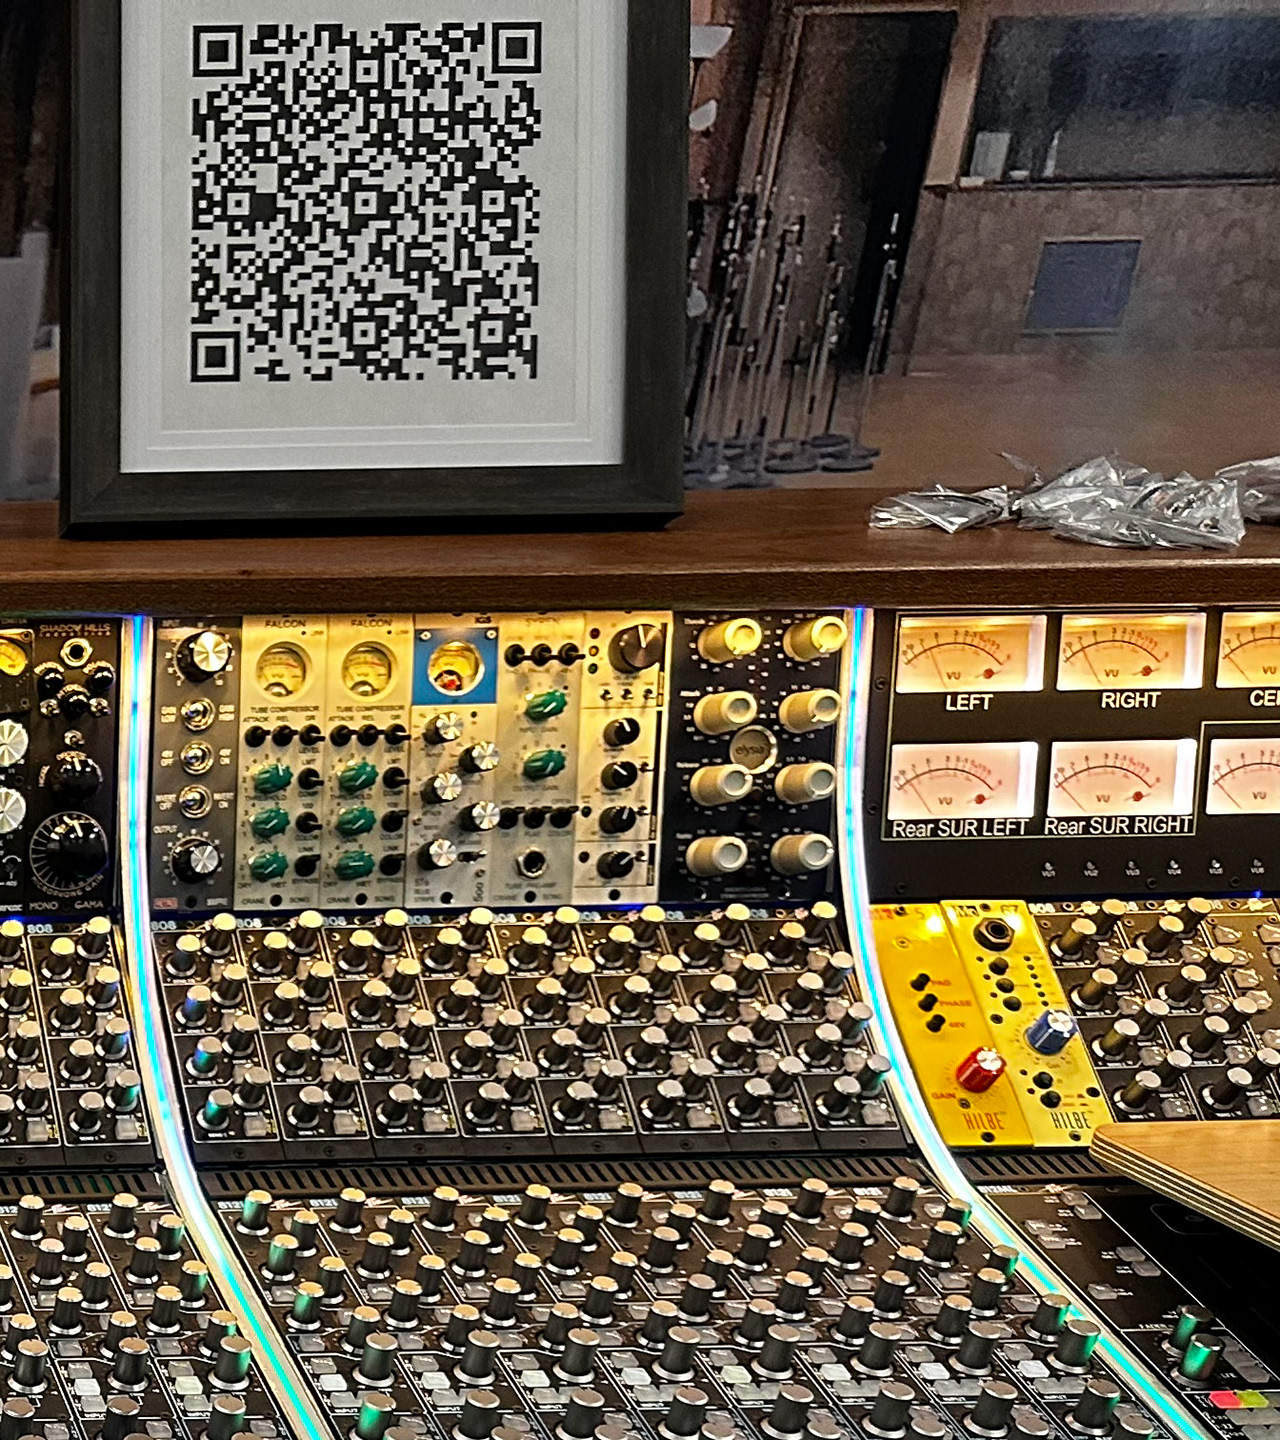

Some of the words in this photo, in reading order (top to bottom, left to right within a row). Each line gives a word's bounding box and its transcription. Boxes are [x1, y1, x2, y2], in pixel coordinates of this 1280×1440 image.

[39, 623, 82, 633] SHADOW
[84, 623, 111, 632] HILLS
[265, 620, 306, 629] FALCON
[351, 619, 393, 628] FALCON
[946, 670, 961, 680] VU
[1104, 668, 1119, 679] VU
[1262, 666, 1277, 676] VU
[945, 693, 994, 711] LEFT
[1101, 690, 1161, 710] RIGHT
[251, 706, 268, 714] TUBE
[269, 705, 319, 714] COMPRESSOR
[735, 744, 766, 757] elysia
[938, 796, 953, 806] VU
[1096, 794, 1111, 804] VU
[1252, 792, 1267, 801] VU
[892, 820, 935, 838] Rear
[938, 819, 978, 837] SUR
[982, 817, 1030, 836] LEFT
[1044, 817, 1086, 836] Rear
[1089, 816, 1130, 835] SUR
[1133, 814, 1193, 834] RIGHT
[29, 901, 59, 910] MONO
[74, 901, 104, 909] GAMA
[963, 1111, 1004, 1131] HILBE
[1052, 1111, 1091, 1130] HILBE
